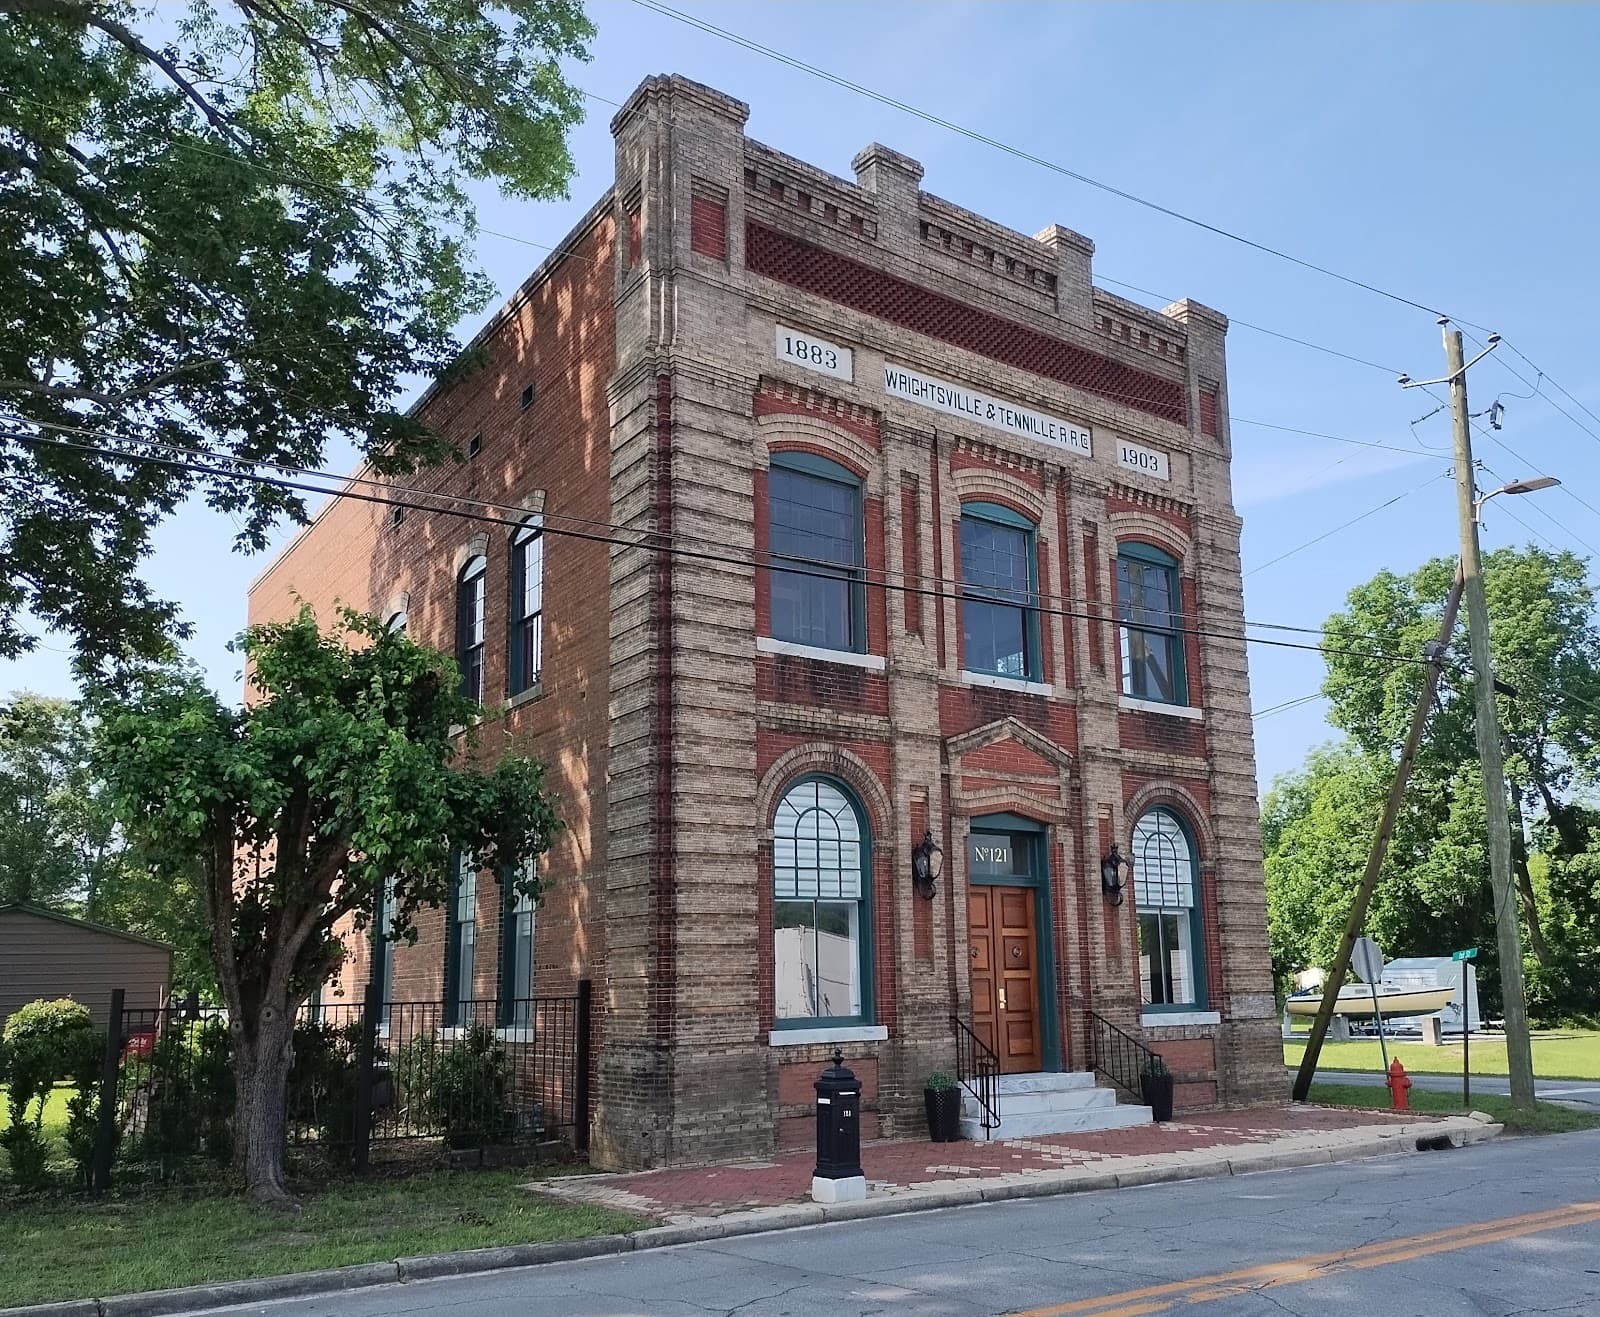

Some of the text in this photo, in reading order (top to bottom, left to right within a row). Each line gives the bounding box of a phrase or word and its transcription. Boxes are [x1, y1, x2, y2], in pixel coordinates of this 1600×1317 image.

[785, 337, 837, 369] 1883
[885, 368, 982, 417] WRIGHTSVILLE
[986, 402, 996, 421] &
[998, 407, 1057, 440] TENNILLE
[1122, 447, 1158, 471] 1903
